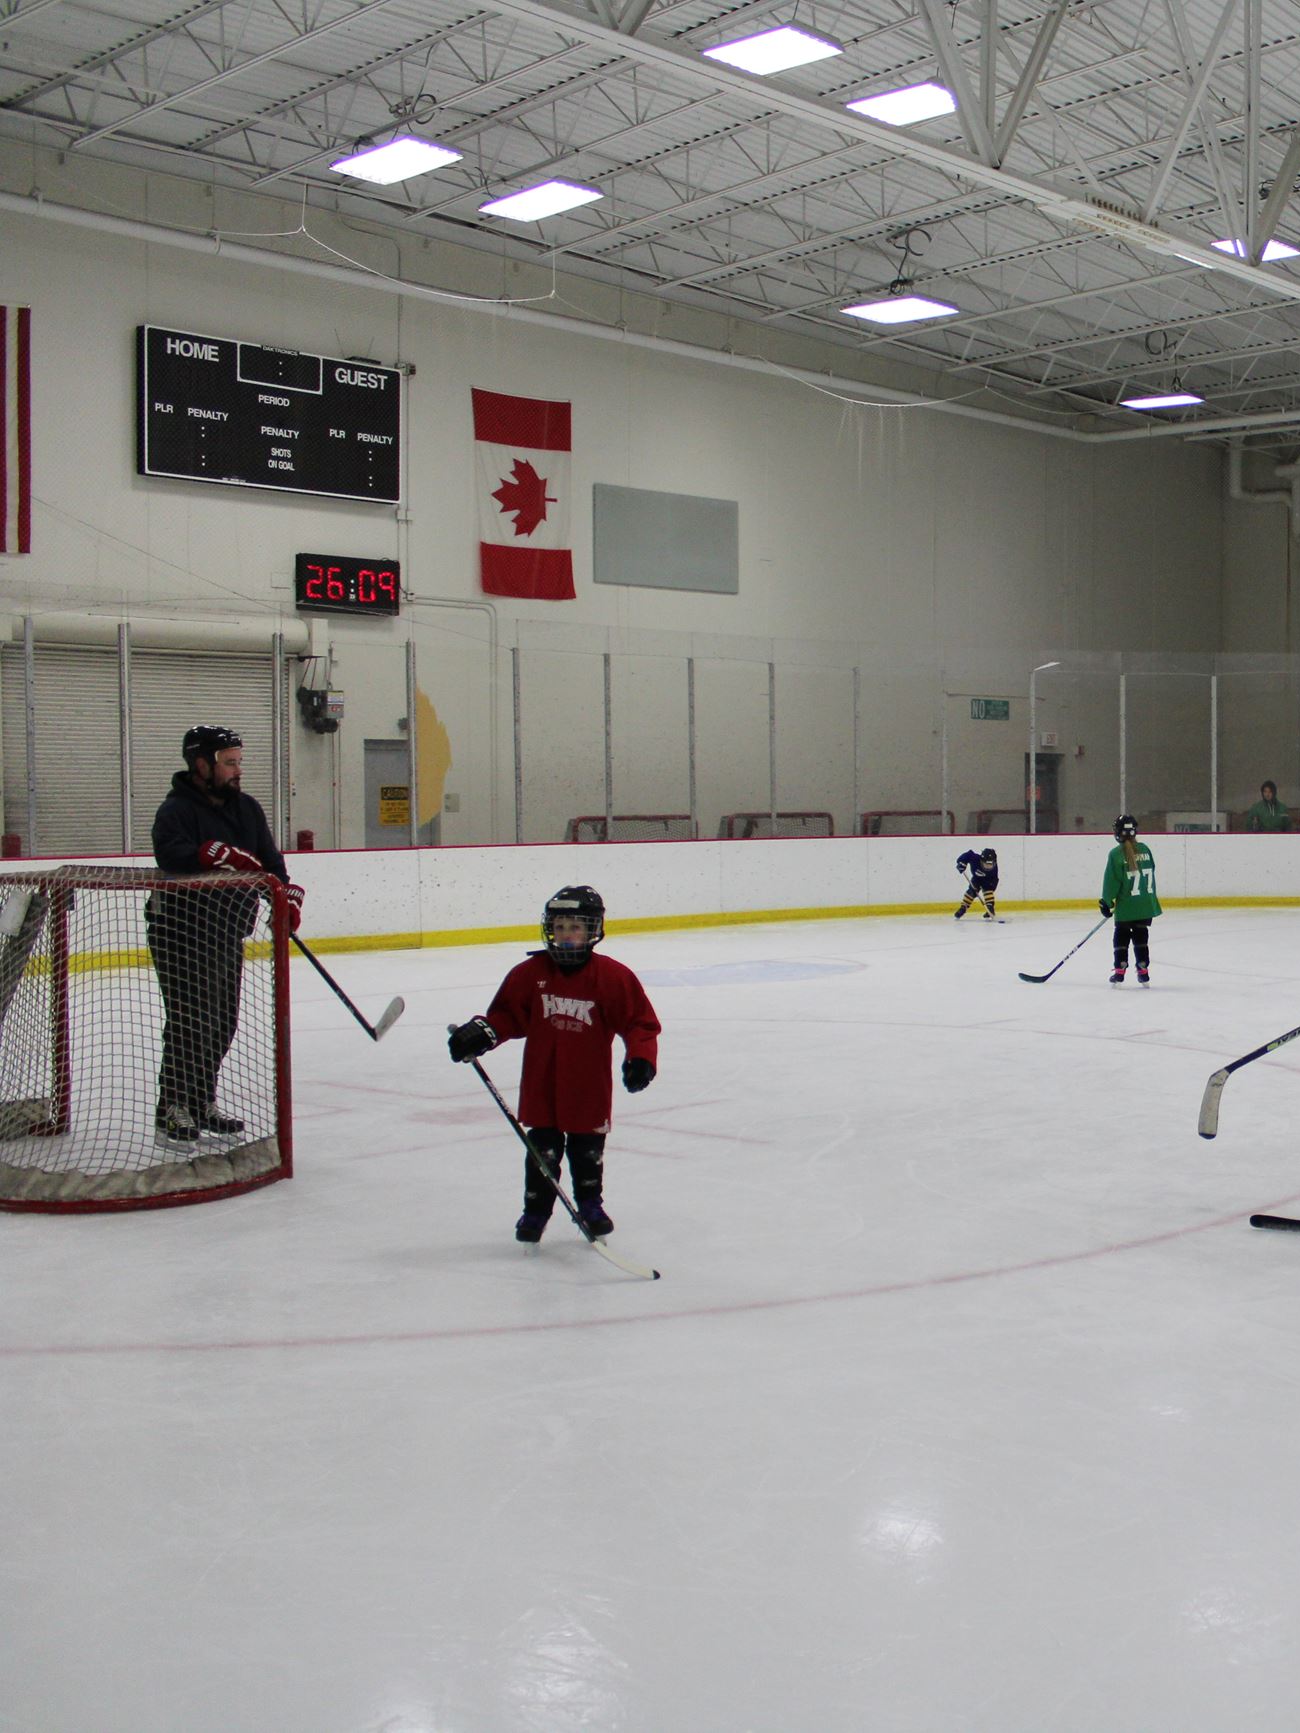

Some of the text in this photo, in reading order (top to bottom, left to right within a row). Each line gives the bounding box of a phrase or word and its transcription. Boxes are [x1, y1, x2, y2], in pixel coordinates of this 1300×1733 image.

[166, 337, 219, 362] HOME
[335, 367, 388, 390] GUEST
[258, 394, 290, 407] PERIOD
[154, 402, 174, 414] PLR
[187, 407, 229, 421] PENALTY
[260, 425, 300, 439] PENALTY
[329, 428, 346, 439] PLR
[357, 432, 393, 445] PENALTY
[270, 447, 292, 459] SHOTS
[267, 459, 296, 471] ON GOAL
[305, 564, 396, 603] 26:09
[971, 700, 985, 719] NO
[1126, 868, 1154, 897] 77
